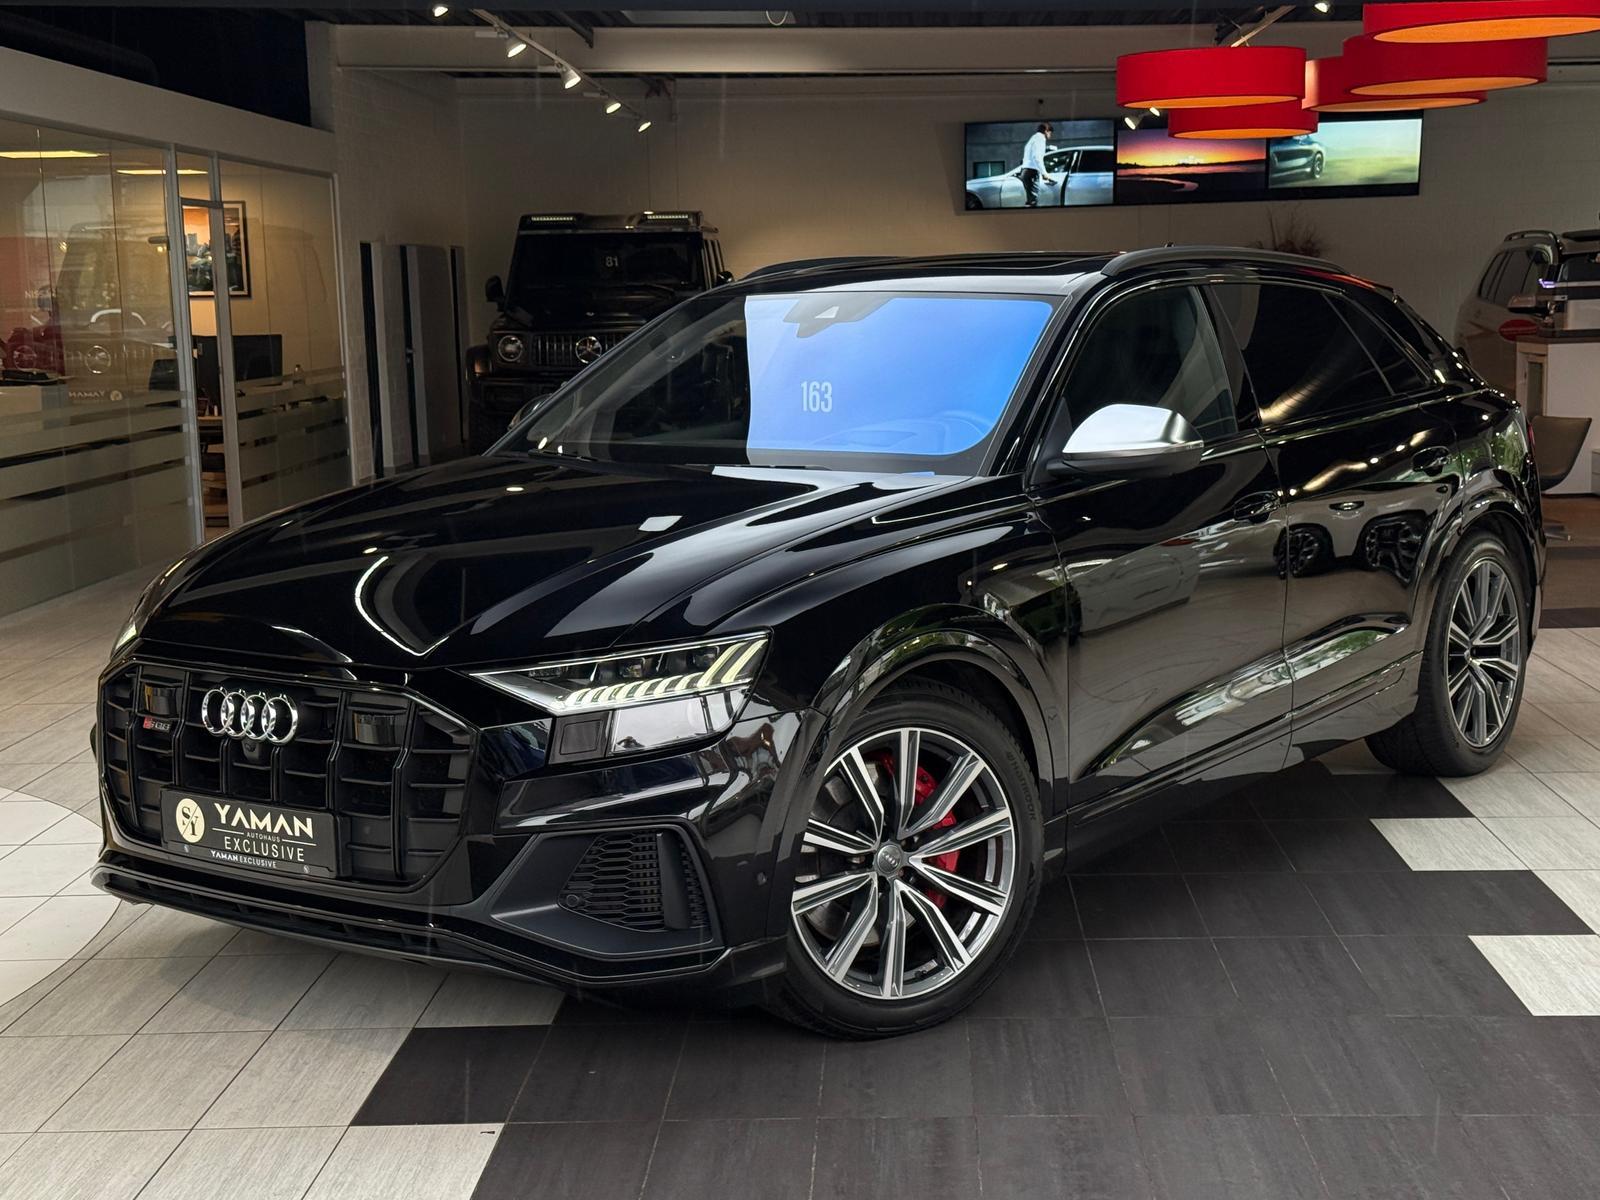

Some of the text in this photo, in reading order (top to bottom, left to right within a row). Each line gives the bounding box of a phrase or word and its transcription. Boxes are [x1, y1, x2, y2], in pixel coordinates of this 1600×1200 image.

[800, 380, 833, 412] 163
[213, 802, 314, 839] YAMAN
[224, 836, 305, 862] EXCLUSIVE
[246, 832, 281, 843] AUTOHAUS
[210, 850, 278, 869] YAMAN EXCLUSIVE
